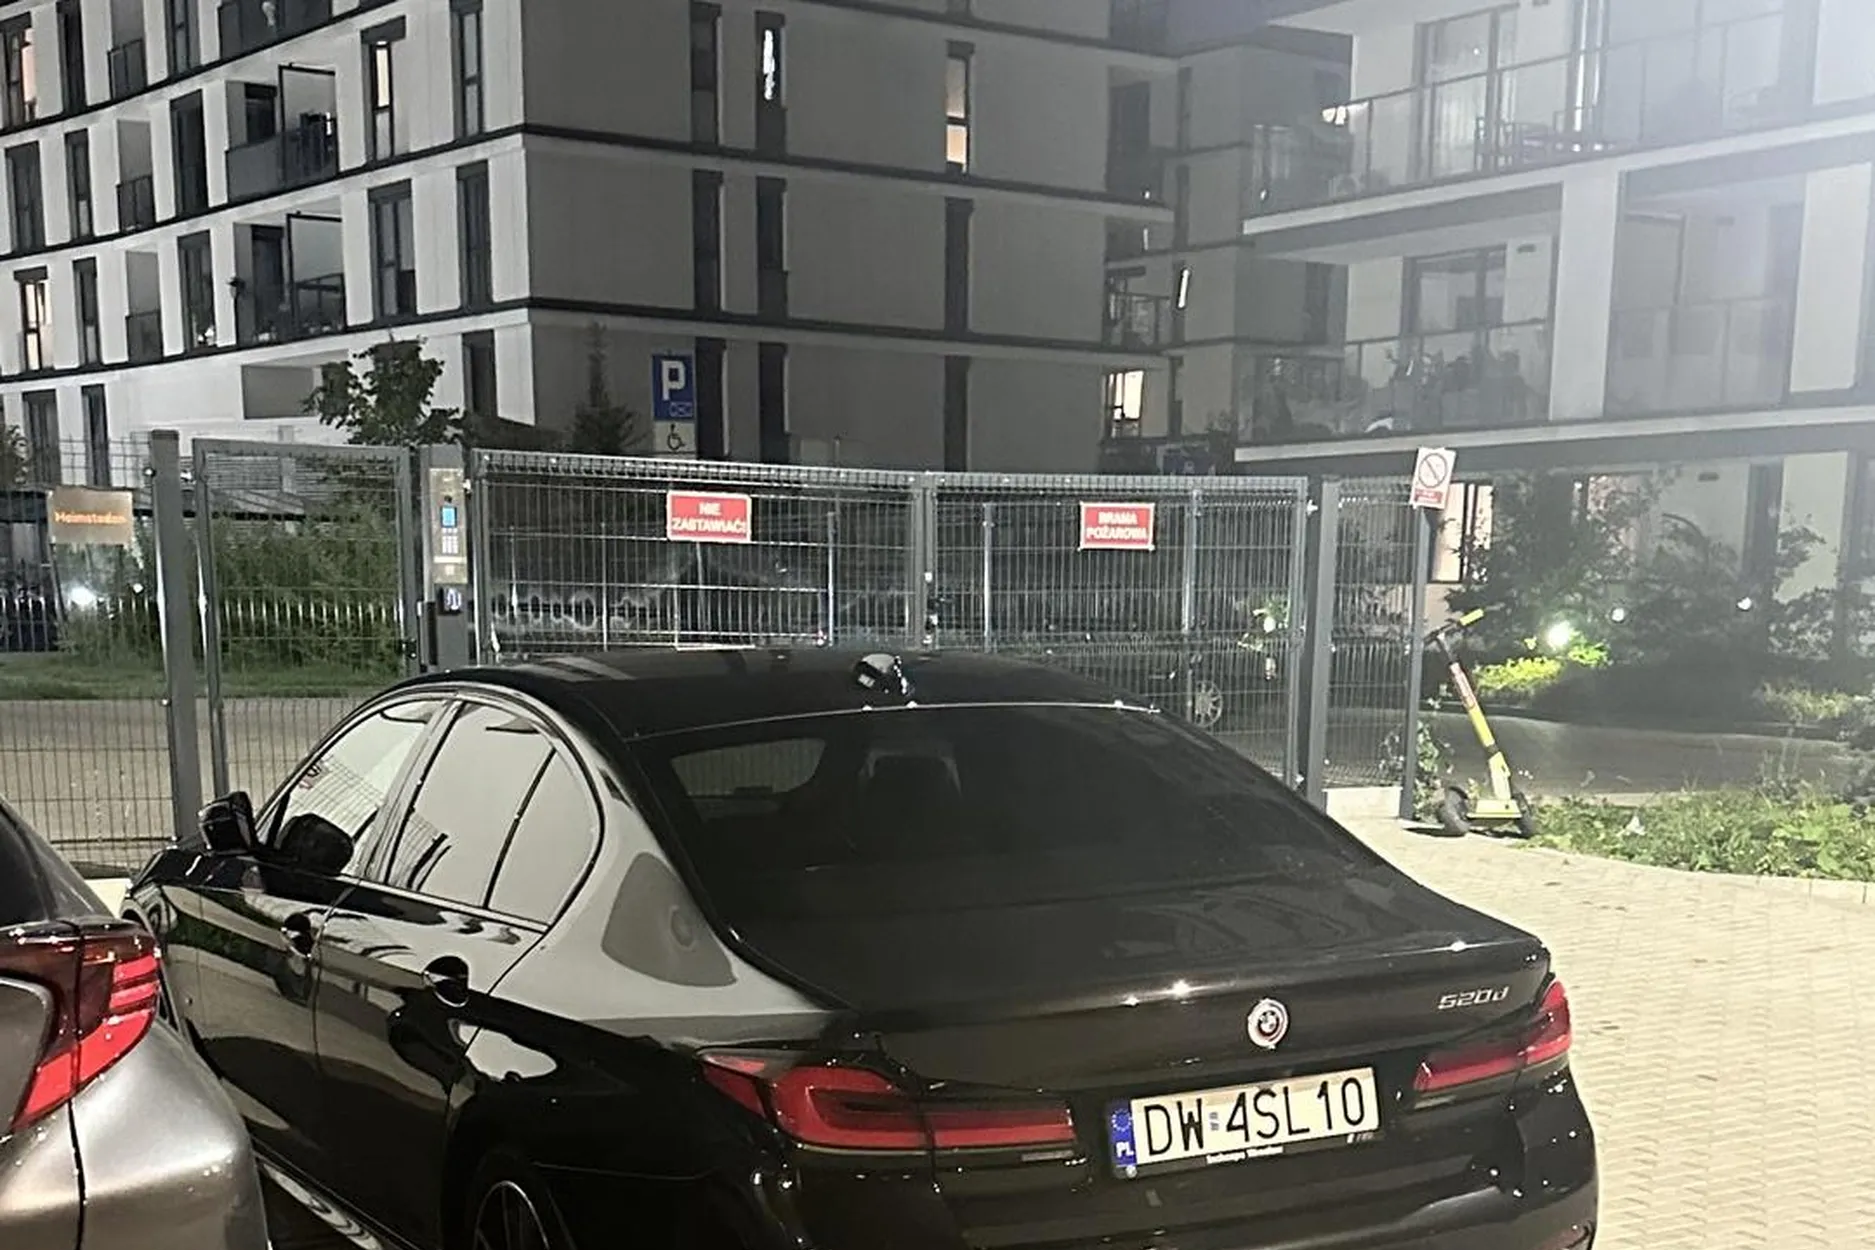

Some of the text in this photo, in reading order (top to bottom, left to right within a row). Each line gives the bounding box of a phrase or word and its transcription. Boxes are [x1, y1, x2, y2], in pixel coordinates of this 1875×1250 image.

[661, 360, 687, 401] P
[699, 502, 722, 516] NIE
[1098, 511, 1138, 525] BRAMA
[1086, 525, 1148, 540] POŻAROWA
[1438, 986, 1510, 1010] 520d
[1144, 1077, 1364, 1156] DW 4SL10
[1116, 1141, 1135, 1158] PL
